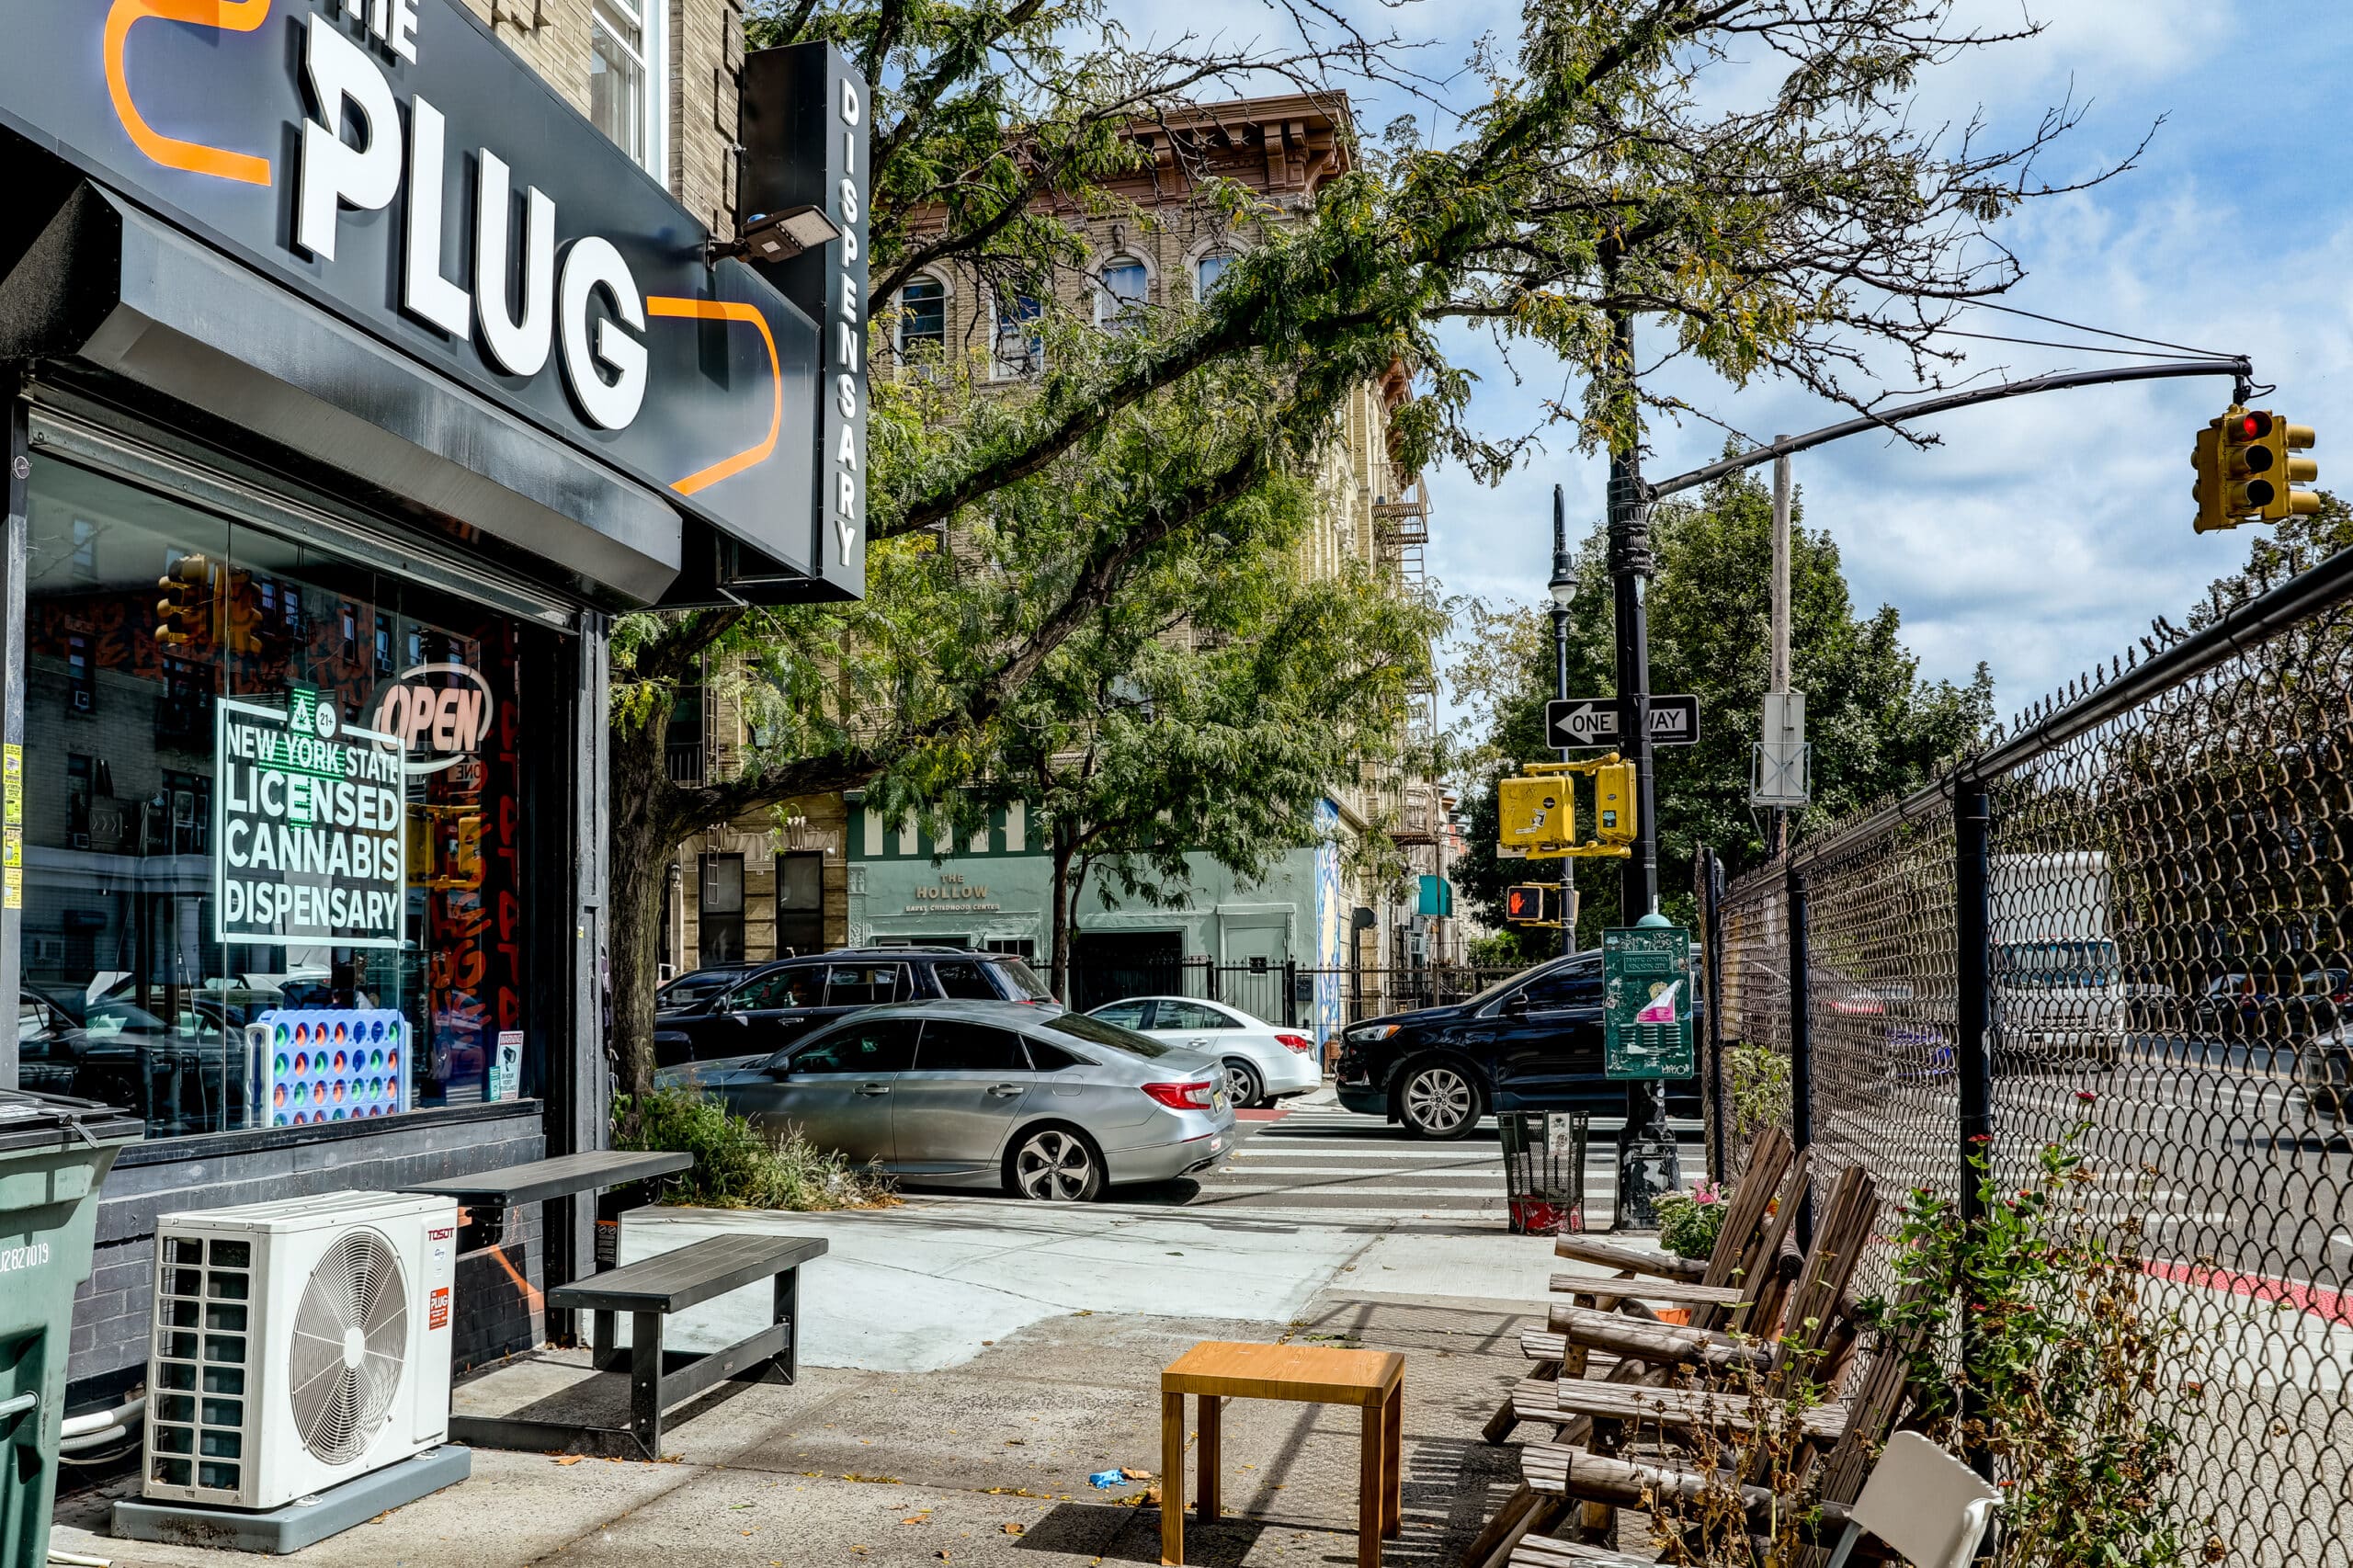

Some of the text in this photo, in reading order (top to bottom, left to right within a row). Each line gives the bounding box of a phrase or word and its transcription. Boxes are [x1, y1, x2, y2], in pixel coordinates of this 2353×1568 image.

[297, 11, 649, 430] PLUG
[835, 77, 860, 566] DISPENSARY
[320, 712, 334, 727] 21+
[380, 684, 483, 751] OPEN
[1572, 710, 1680, 733] ONE AY
[227, 722, 399, 784] NEW YORK STATE
[227, 762, 399, 831] LICENSED
[226, 818, 399, 881] CANNABIS
[915, 885, 987, 899] HOLLOW
[940, 874, 964, 883] THE
[225, 879, 398, 930] DISPENSARY
[972, 903, 1000, 911] CENTER
[427, 1227, 455, 1242] TOSOT
[431, 1294, 449, 1310] PLUG
